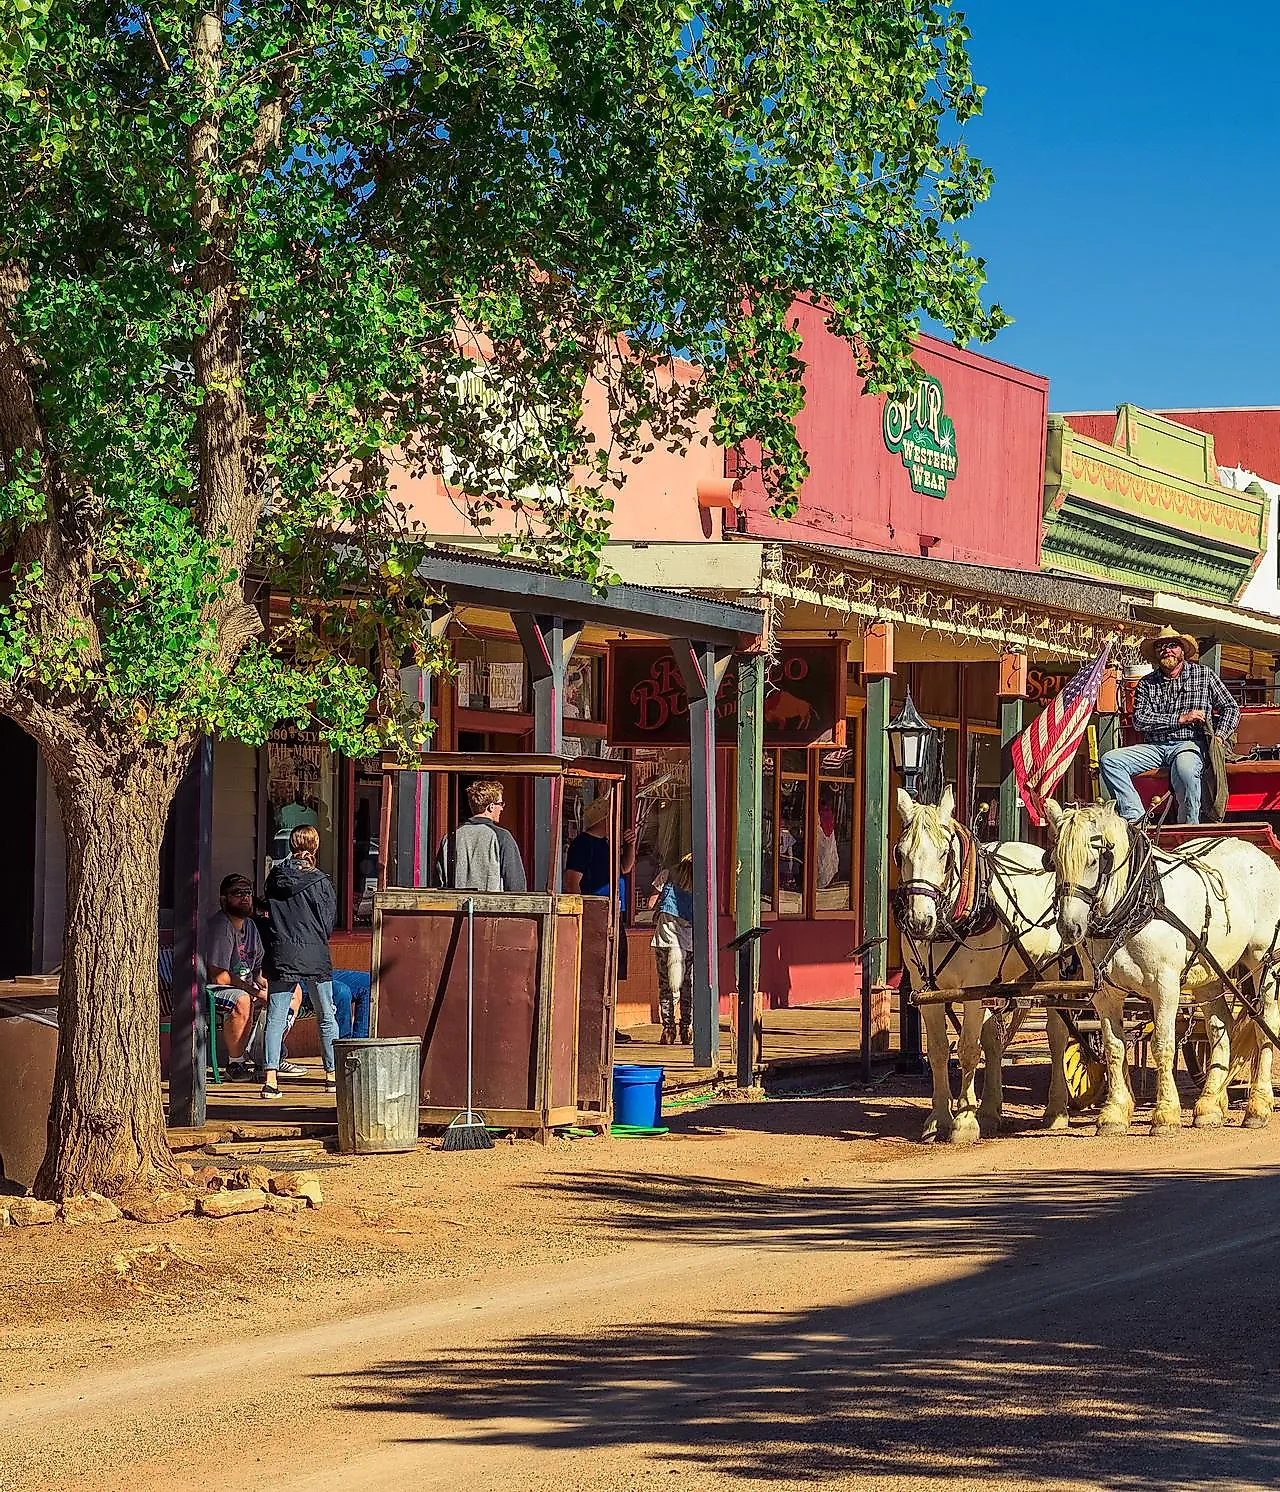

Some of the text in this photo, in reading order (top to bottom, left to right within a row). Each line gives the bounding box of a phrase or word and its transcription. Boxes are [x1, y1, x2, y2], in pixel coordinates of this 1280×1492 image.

[886, 379, 942, 445] SPUR
[902, 439, 957, 473] WESTERN
[912, 464, 946, 492] WEAR
[1027, 669, 1068, 701] SPU
[297, 730, 319, 742] STY
